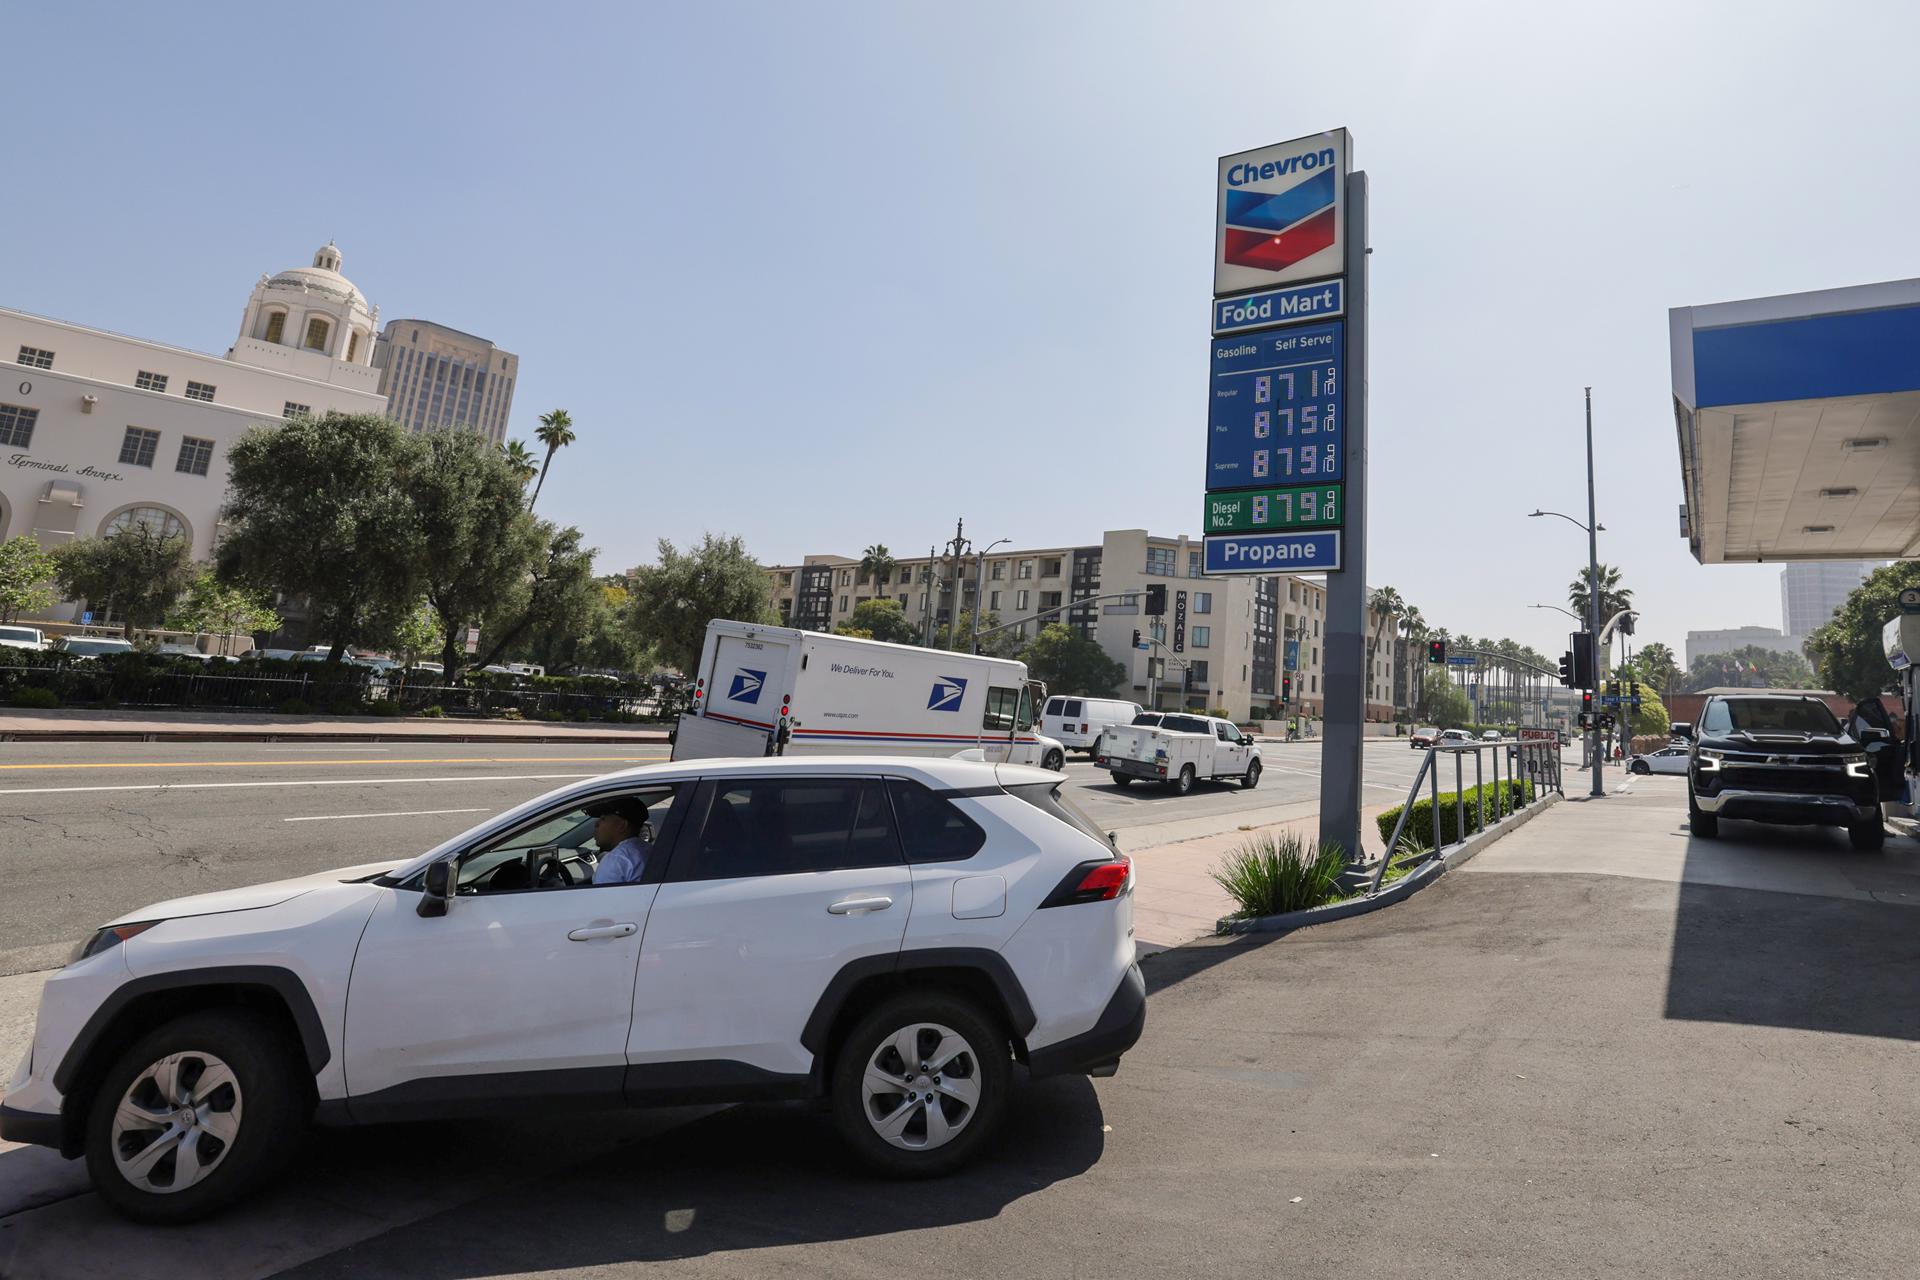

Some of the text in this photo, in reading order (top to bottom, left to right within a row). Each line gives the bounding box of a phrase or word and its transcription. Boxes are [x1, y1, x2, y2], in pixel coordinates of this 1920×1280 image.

[1227, 147, 1335, 187] Chevron
[1222, 289, 1333, 324] Food Mart
[1216, 335, 1332, 359] Gasoline Self Serve
[19, 381, 32, 395] O
[1216, 389, 1239, 398] Regular
[8, 453, 69, 473] Terminal
[1215, 462, 1239, 470] Supreme
[1212, 501, 1240, 514] Diesel
[1212, 515, 1233, 527] No.2
[1224, 542, 1316, 565] Propane
[1908, 593, 1916, 602] 3
[1175, 592, 1186, 651] MOZAIC
[831, 663, 842, 673] We
[843, 664, 868, 675] Deliver
[869, 667, 881, 677] For
[1521, 730, 1555, 740] PUBLIC
